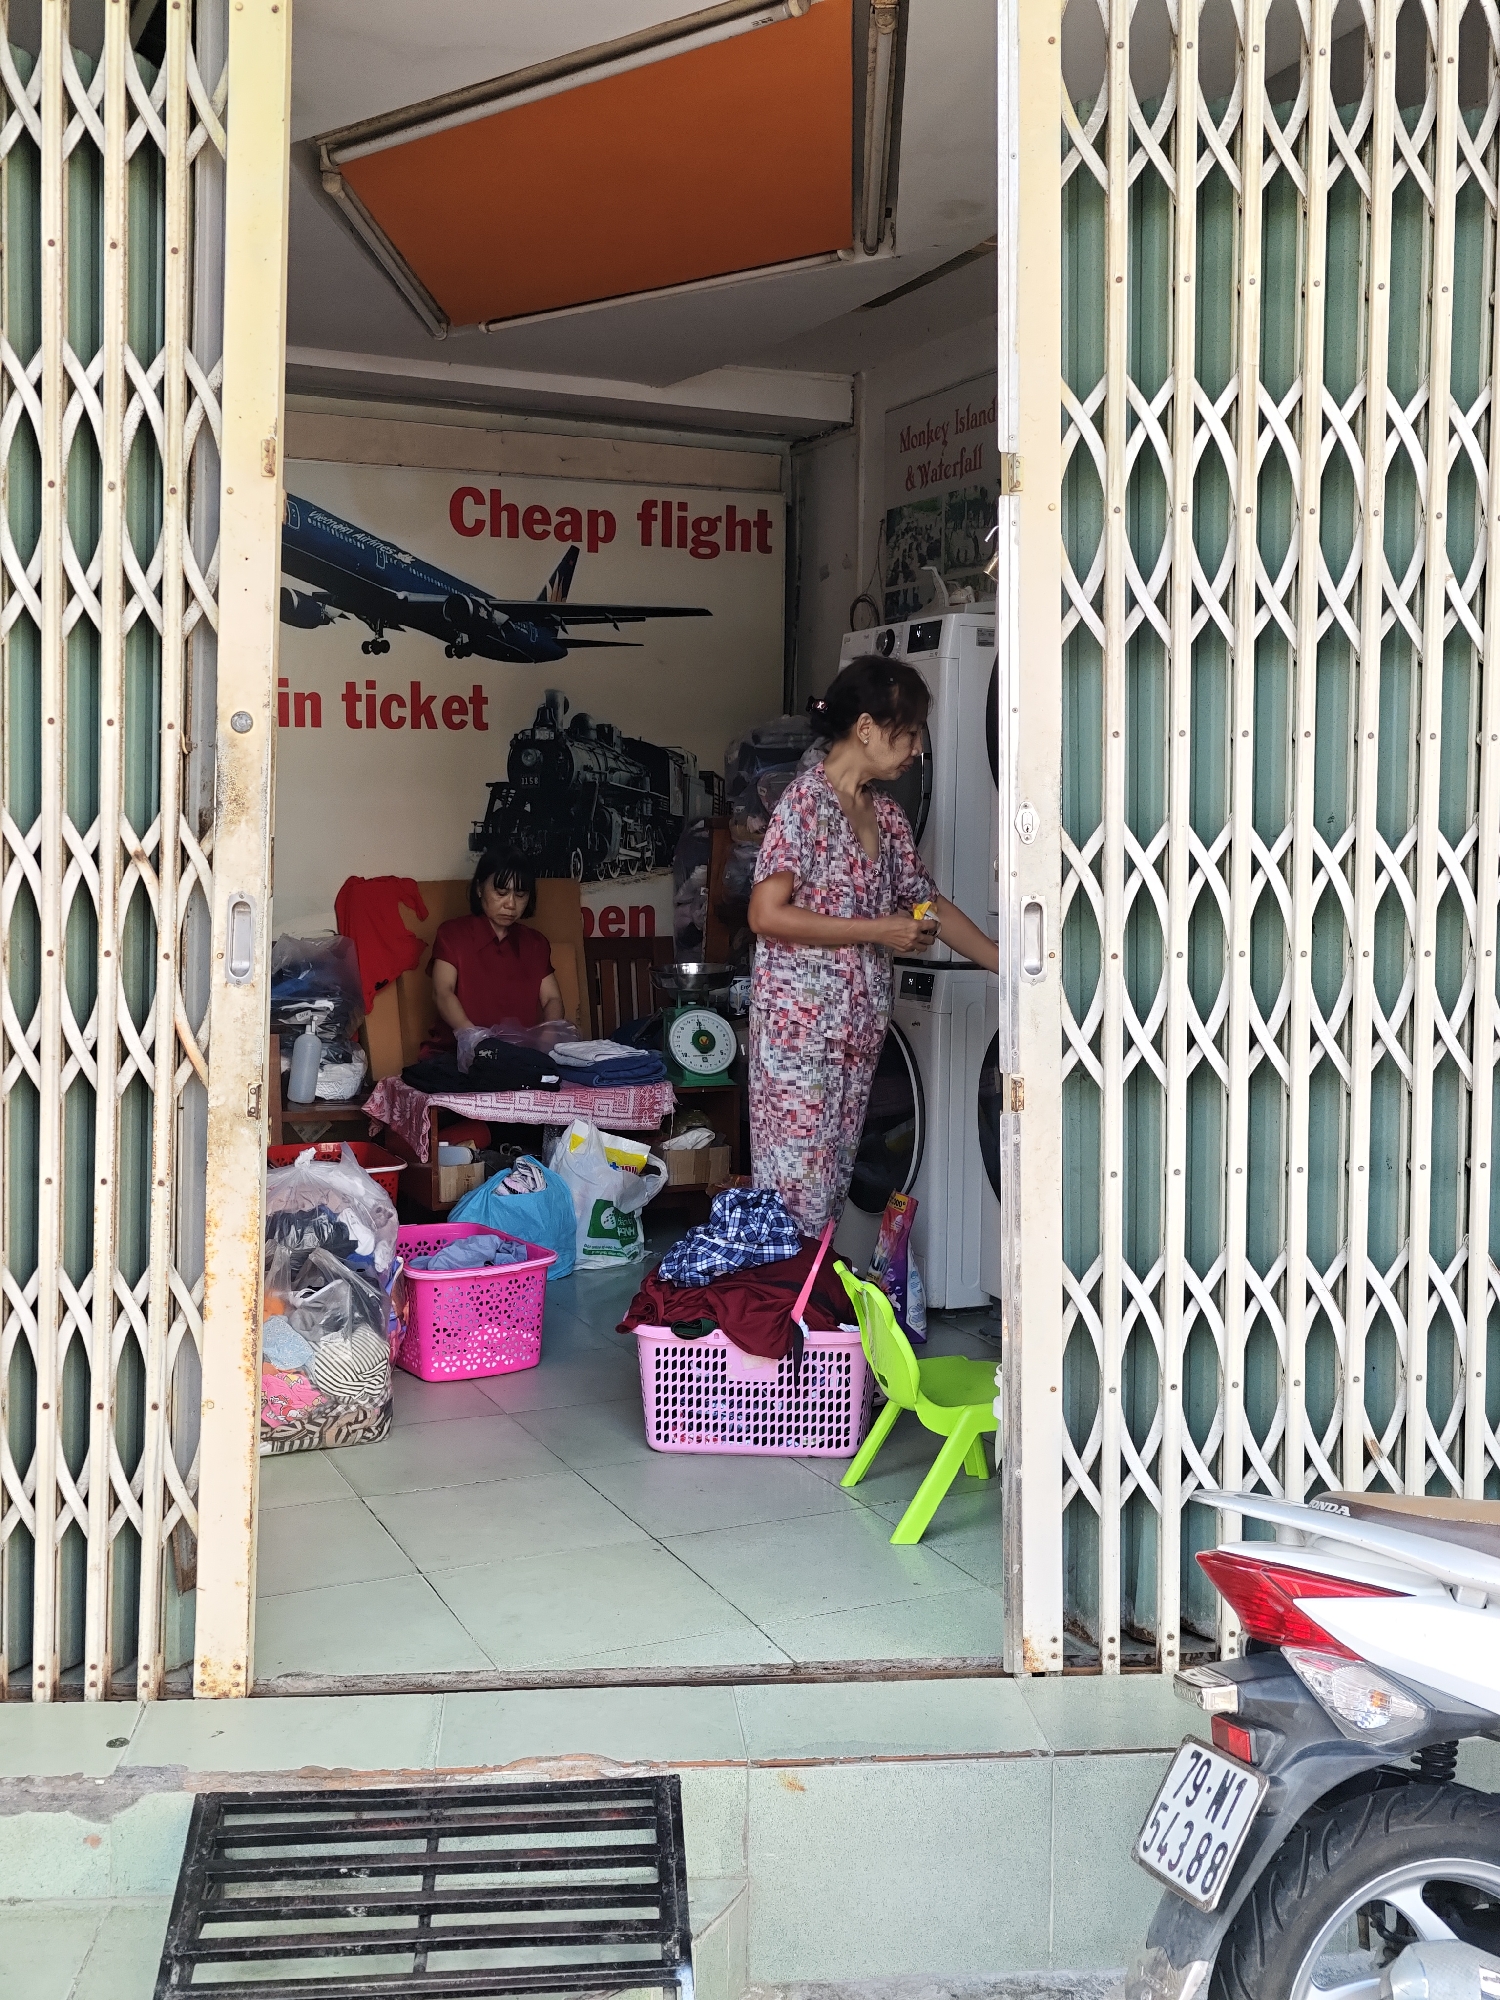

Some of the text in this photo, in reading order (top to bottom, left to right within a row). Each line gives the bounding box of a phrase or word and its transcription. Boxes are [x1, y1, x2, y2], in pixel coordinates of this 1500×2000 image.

[900, 395, 997, 456] Monkey Island
[905, 442, 983, 492] & Waterfall
[450, 486, 773, 560] Cheap flight
[341, 680, 489, 731] ticket
[1308, 1500, 1351, 1517] ONDA
[1142, 1801, 1229, 1895] 543.88
